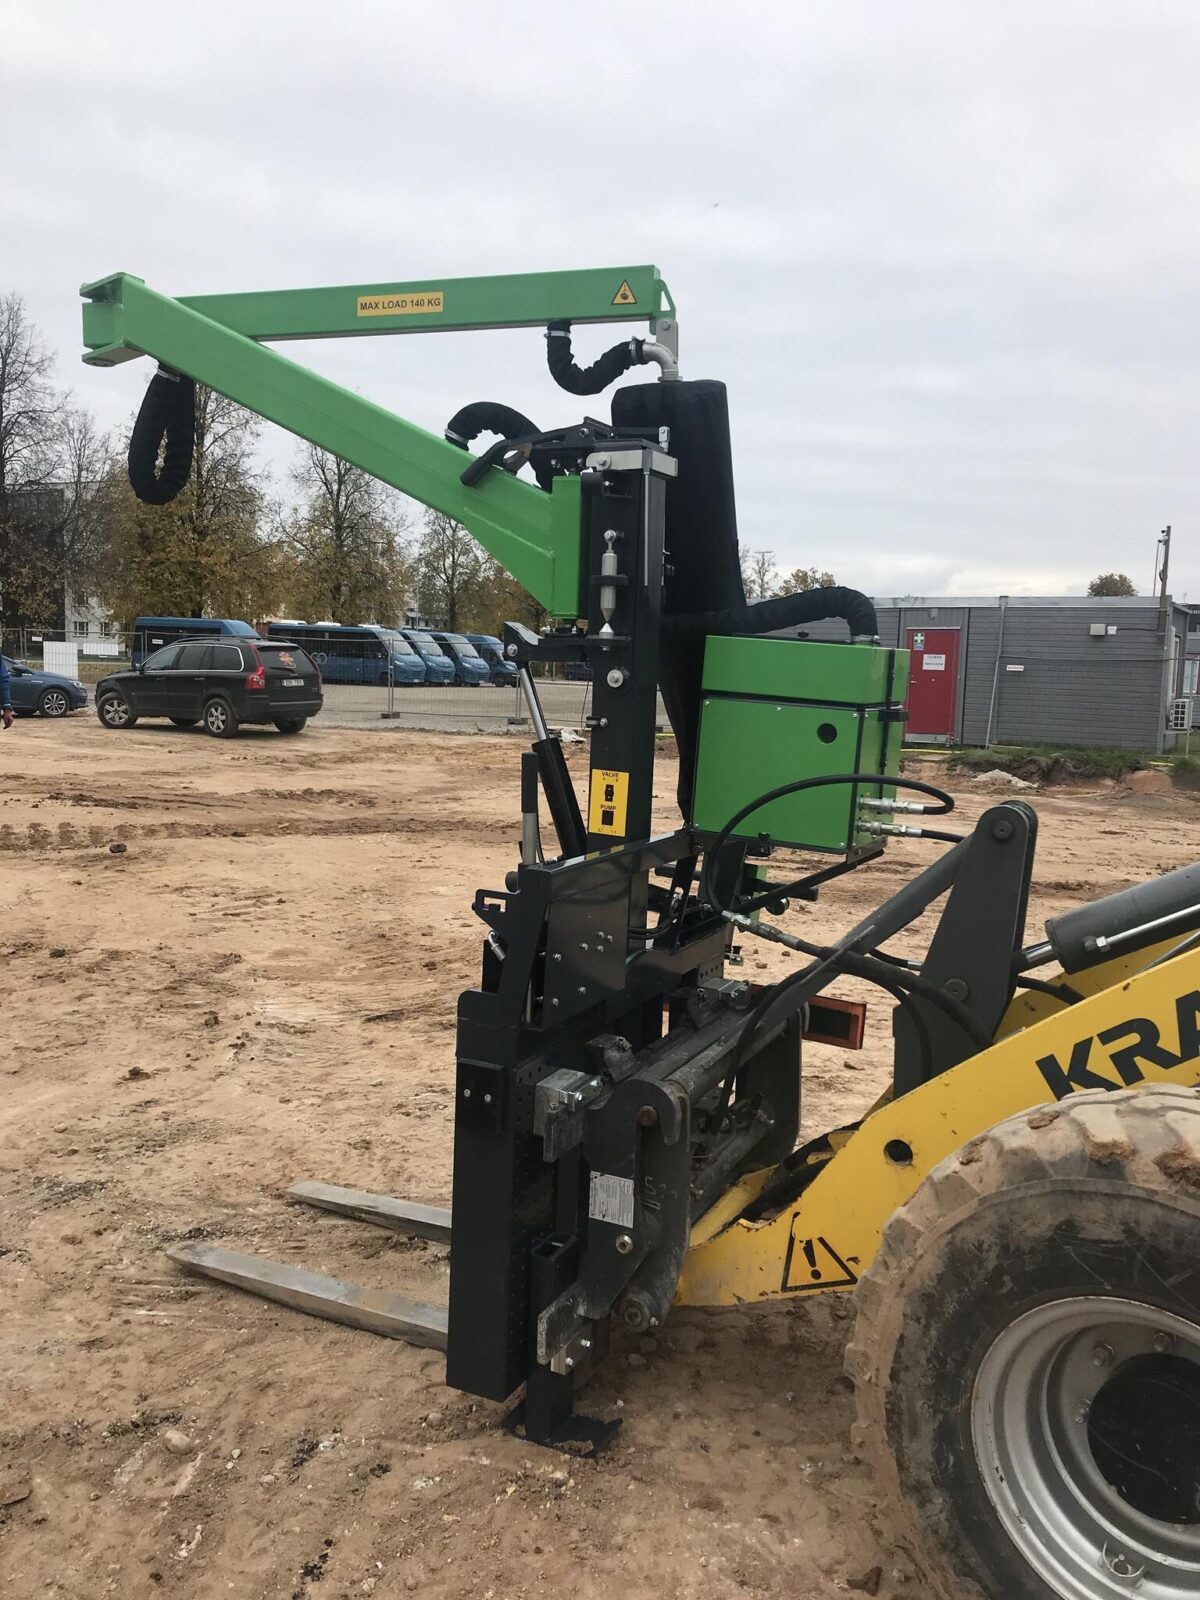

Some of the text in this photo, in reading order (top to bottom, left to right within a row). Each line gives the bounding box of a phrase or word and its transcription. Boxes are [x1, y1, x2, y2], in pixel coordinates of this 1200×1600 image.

[360, 297, 441, 311] MAX LOAD 140 KG
